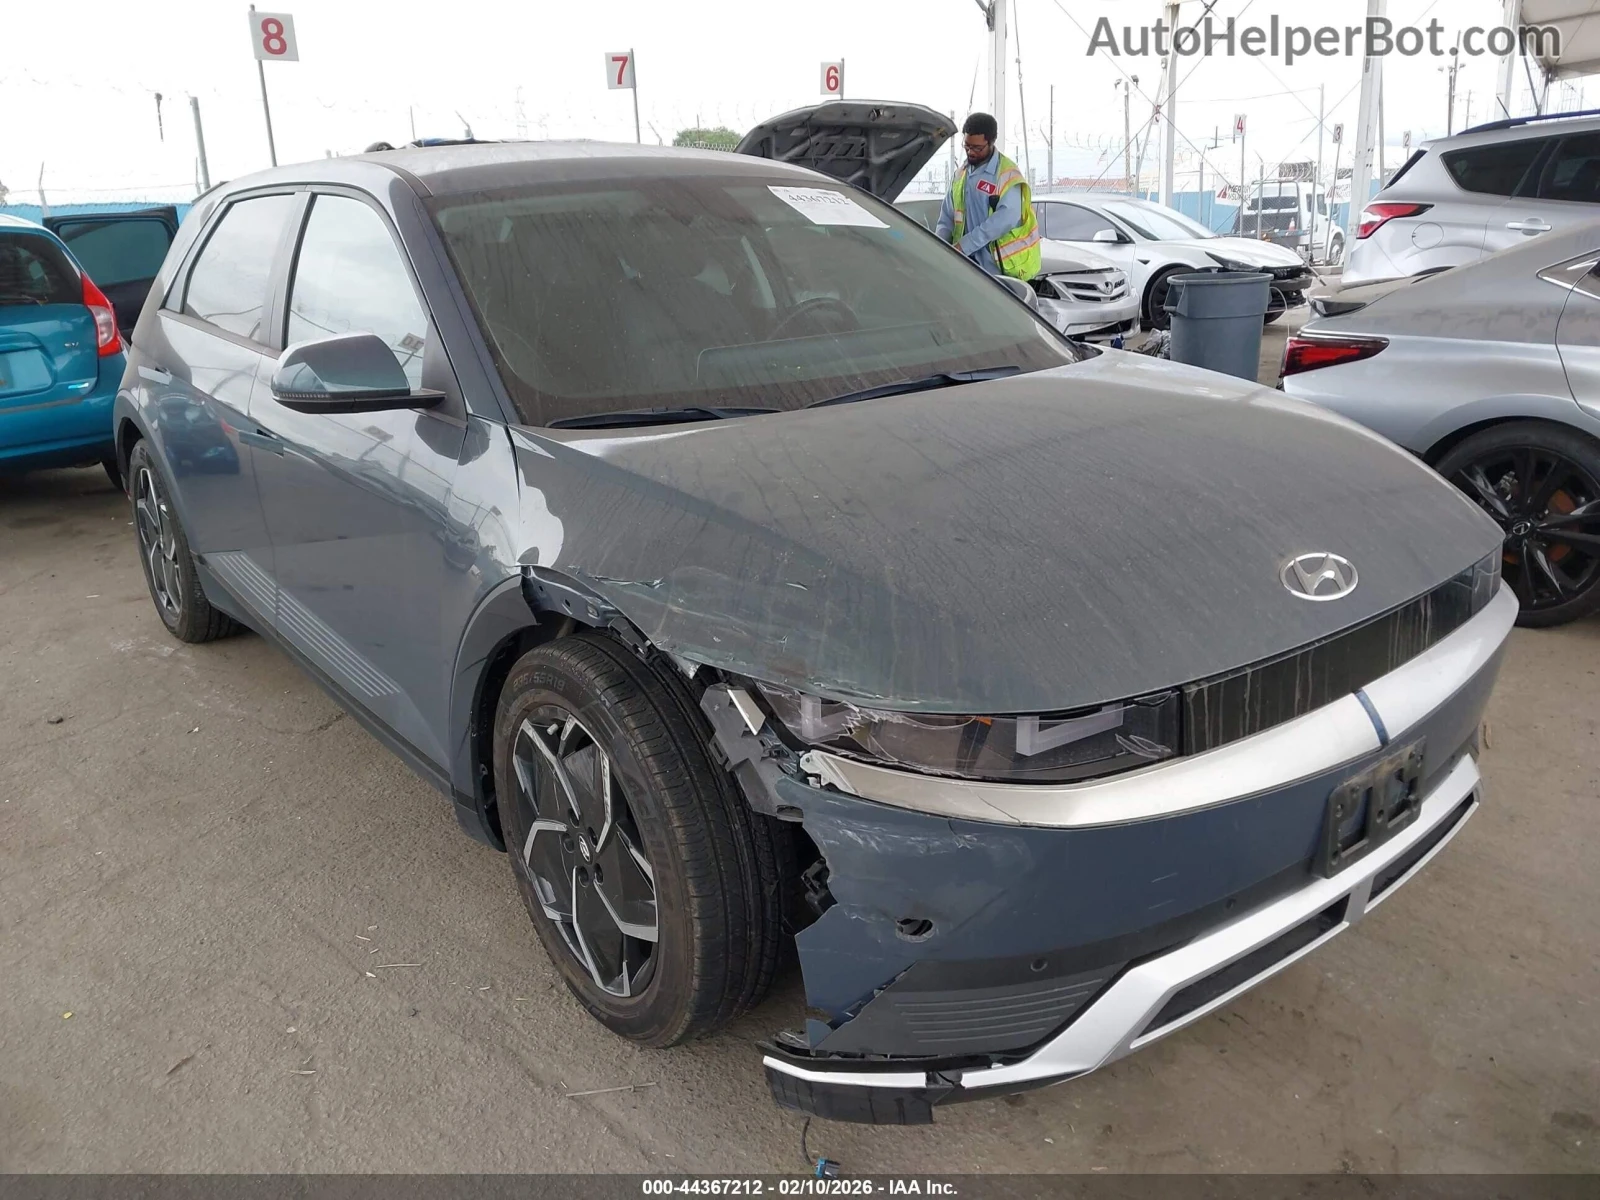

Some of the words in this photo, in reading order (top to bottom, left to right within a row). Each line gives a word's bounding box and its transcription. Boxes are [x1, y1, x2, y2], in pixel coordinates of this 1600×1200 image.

[261, 18, 288, 56] 8
[612, 56, 629, 86] 7
[825, 65, 840, 93] 6
[1236, 115, 1244, 134] 4
[1334, 125, 1342, 142] 3
[788, 194, 850, 206] 44367212
